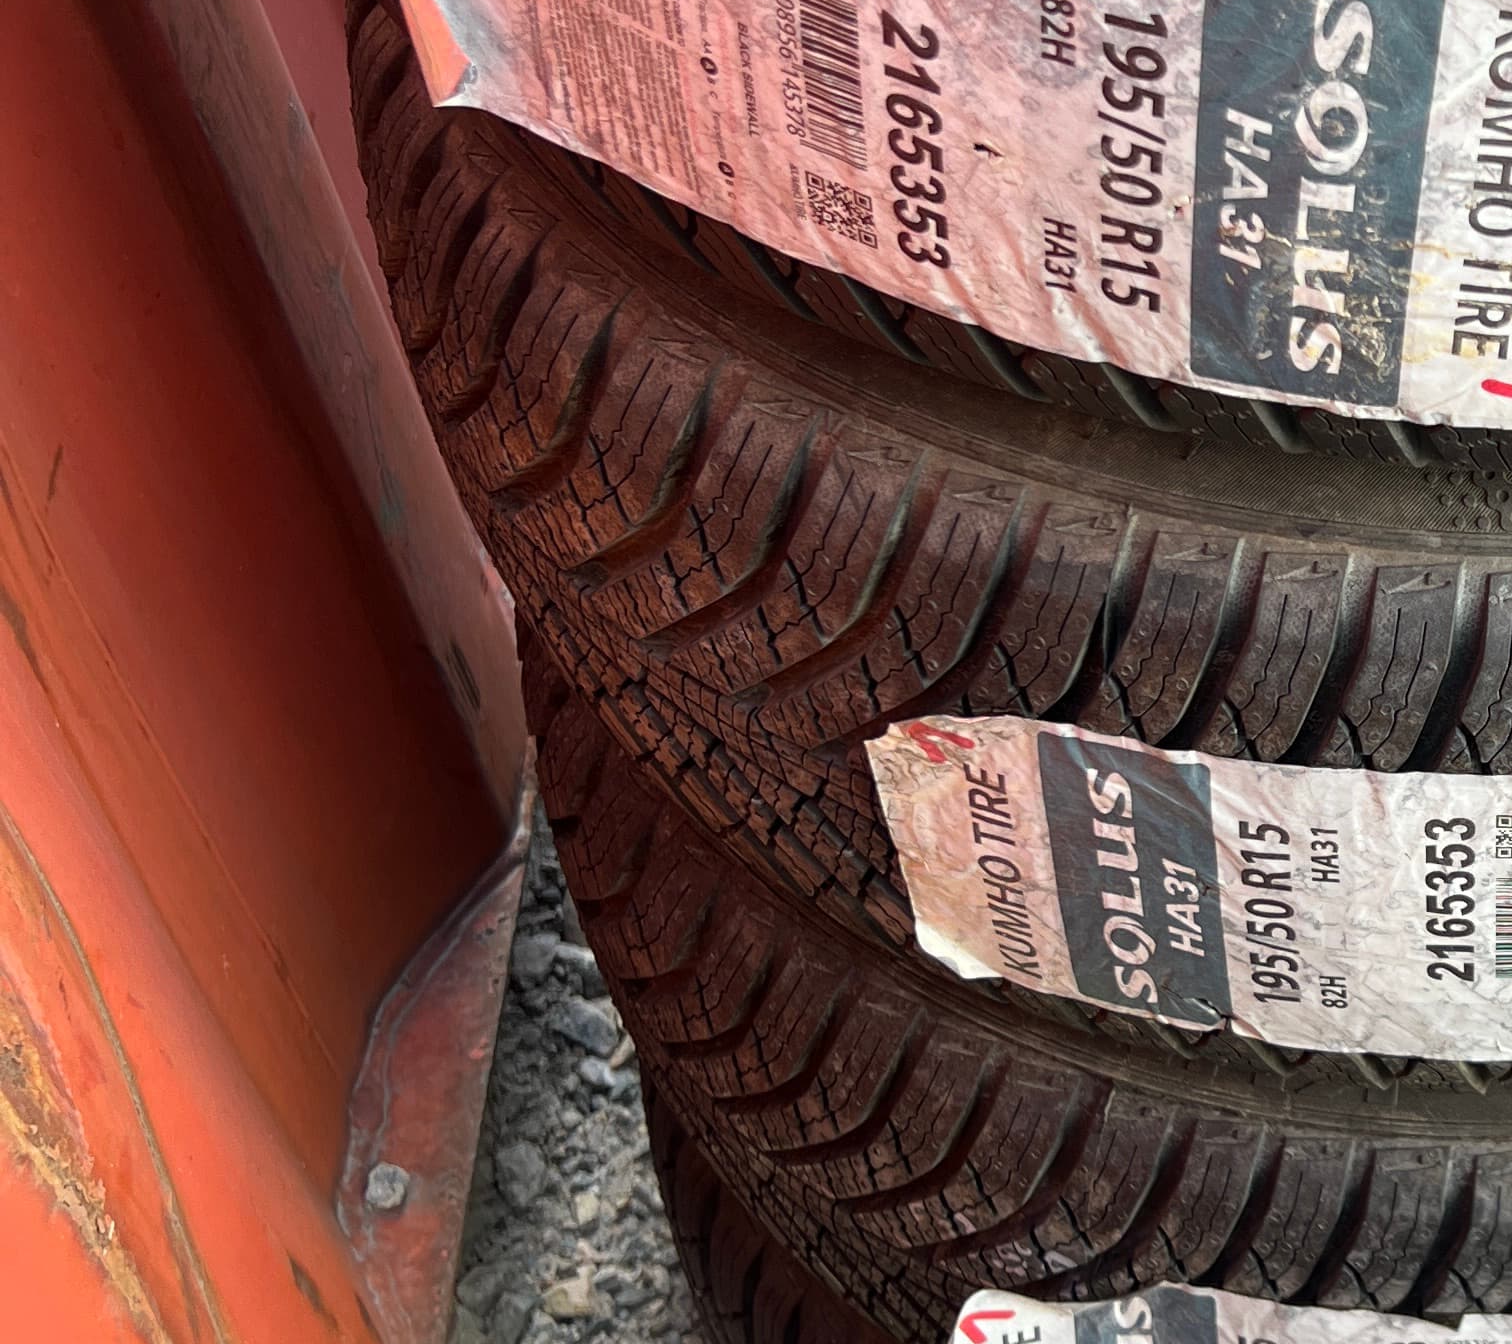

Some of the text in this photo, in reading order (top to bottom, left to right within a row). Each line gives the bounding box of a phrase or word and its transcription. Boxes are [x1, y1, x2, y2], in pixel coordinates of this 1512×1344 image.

[736, 21, 759, 137] BLACK SIDEWALL
[780, 68, 804, 137] 145378
[879, 8, 952, 271] 2165353
[1099, 11, 1168, 315] 195/50 R15
[1040, 216, 1078, 295] HA31
[1218, 107, 1275, 272] HA31
[964, 762, 1044, 980] KUMHO TIRE
[1086, 767, 1160, 1005] SOLUS
[1161, 857, 1206, 957] HA31
[1238, 819, 1301, 1006] 195/50 R15
[1310, 826, 1349, 1011] HA31 82H
[1424, 815, 1478, 982] 2165353
